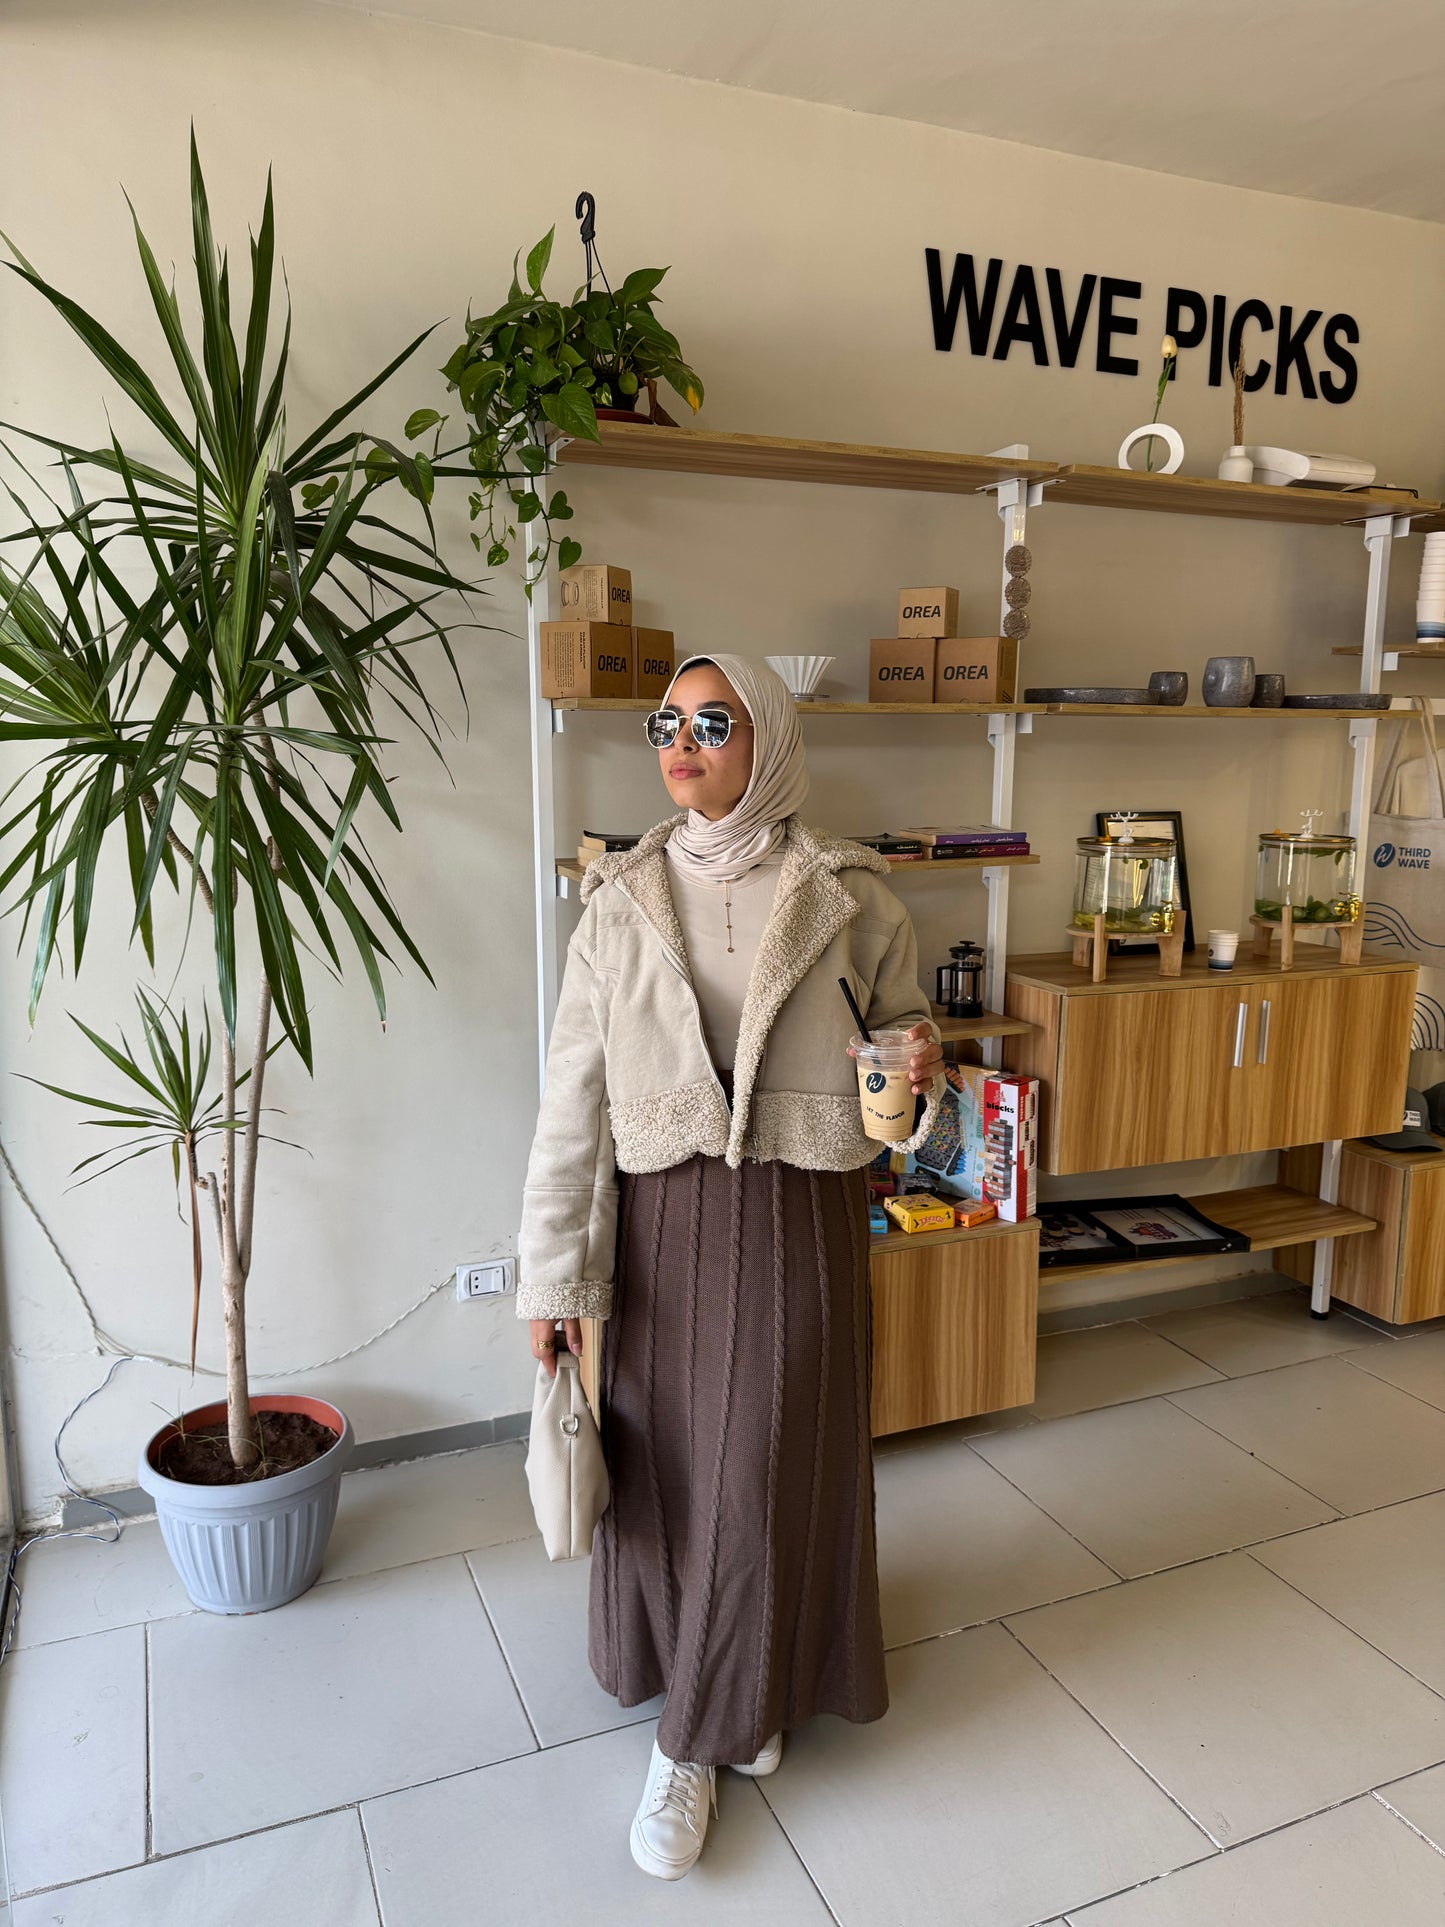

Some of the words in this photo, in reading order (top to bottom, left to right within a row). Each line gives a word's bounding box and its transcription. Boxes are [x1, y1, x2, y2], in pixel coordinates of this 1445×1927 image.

[924, 247, 1142, 377] WAVE
[1165, 286, 1361, 405] PICKS
[611, 586, 631, 604] OREA
[902, 605, 941, 619] OREA
[597, 654, 627, 673] OREA
[643, 658, 670, 676] OREA
[878, 666, 925, 682] OREA
[943, 665, 989, 681] OREA
[1398, 847, 1431, 858] THIRD
[1397, 858, 1430, 869] WAVE
[886, 1111, 904, 1120] FLAVOR
[986, 1102, 1014, 1114] blocks
